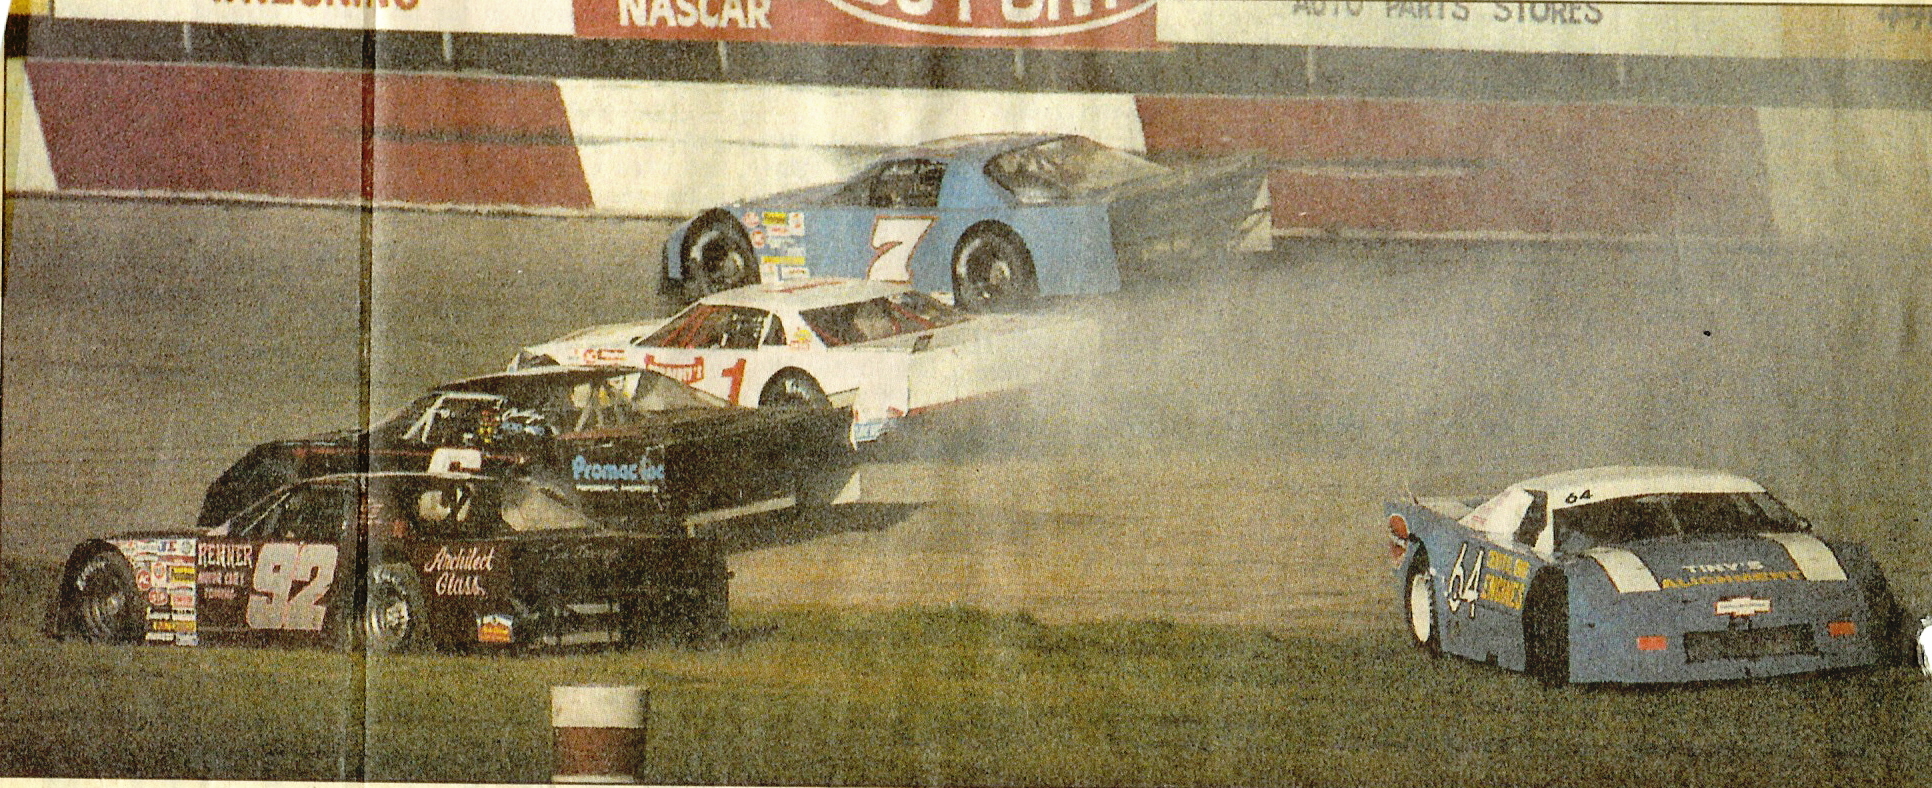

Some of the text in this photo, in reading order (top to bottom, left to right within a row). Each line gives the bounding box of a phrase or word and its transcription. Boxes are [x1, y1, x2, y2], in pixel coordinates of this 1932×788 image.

[619, 0, 772, 29] NASCAR
[866, 214, 939, 285] 7
[722, 357, 747, 406] 1
[571, 454, 638, 481] Promac
[1565, 489, 1594, 504] 64
[424, 546, 496, 572] Architect
[1682, 560, 1764, 573] TINY'S
[246, 542, 339, 631] 92
[1447, 541, 1485, 620] 64
[1662, 571, 1800, 589] ALIGNMENT
